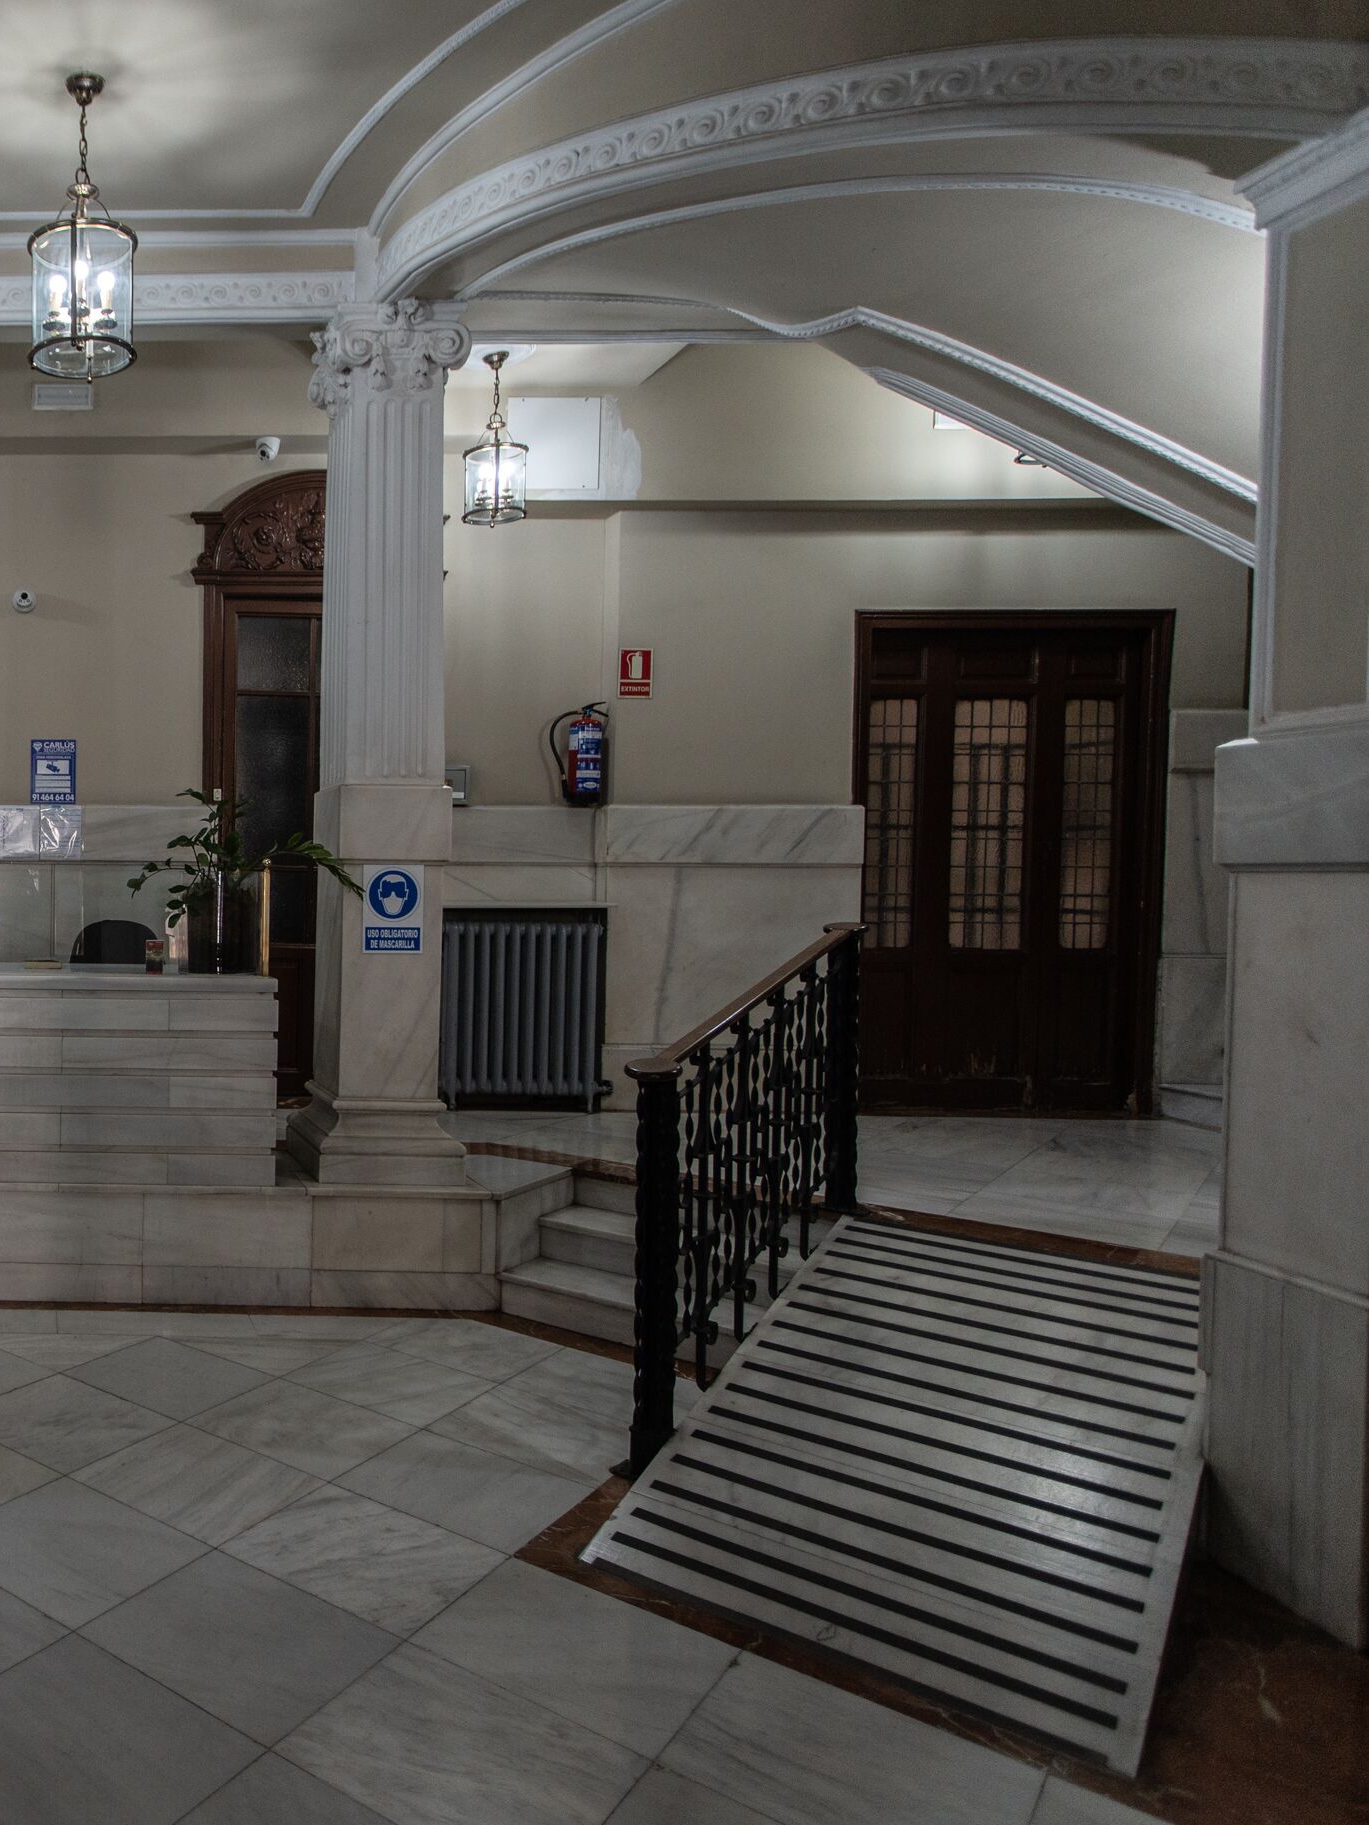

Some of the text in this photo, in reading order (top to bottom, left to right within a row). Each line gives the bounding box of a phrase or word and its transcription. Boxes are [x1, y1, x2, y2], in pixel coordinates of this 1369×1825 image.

[367, 929, 418, 938] USO OBLIGATORIO
[370, 940, 415, 948] DE MASCARILLA
